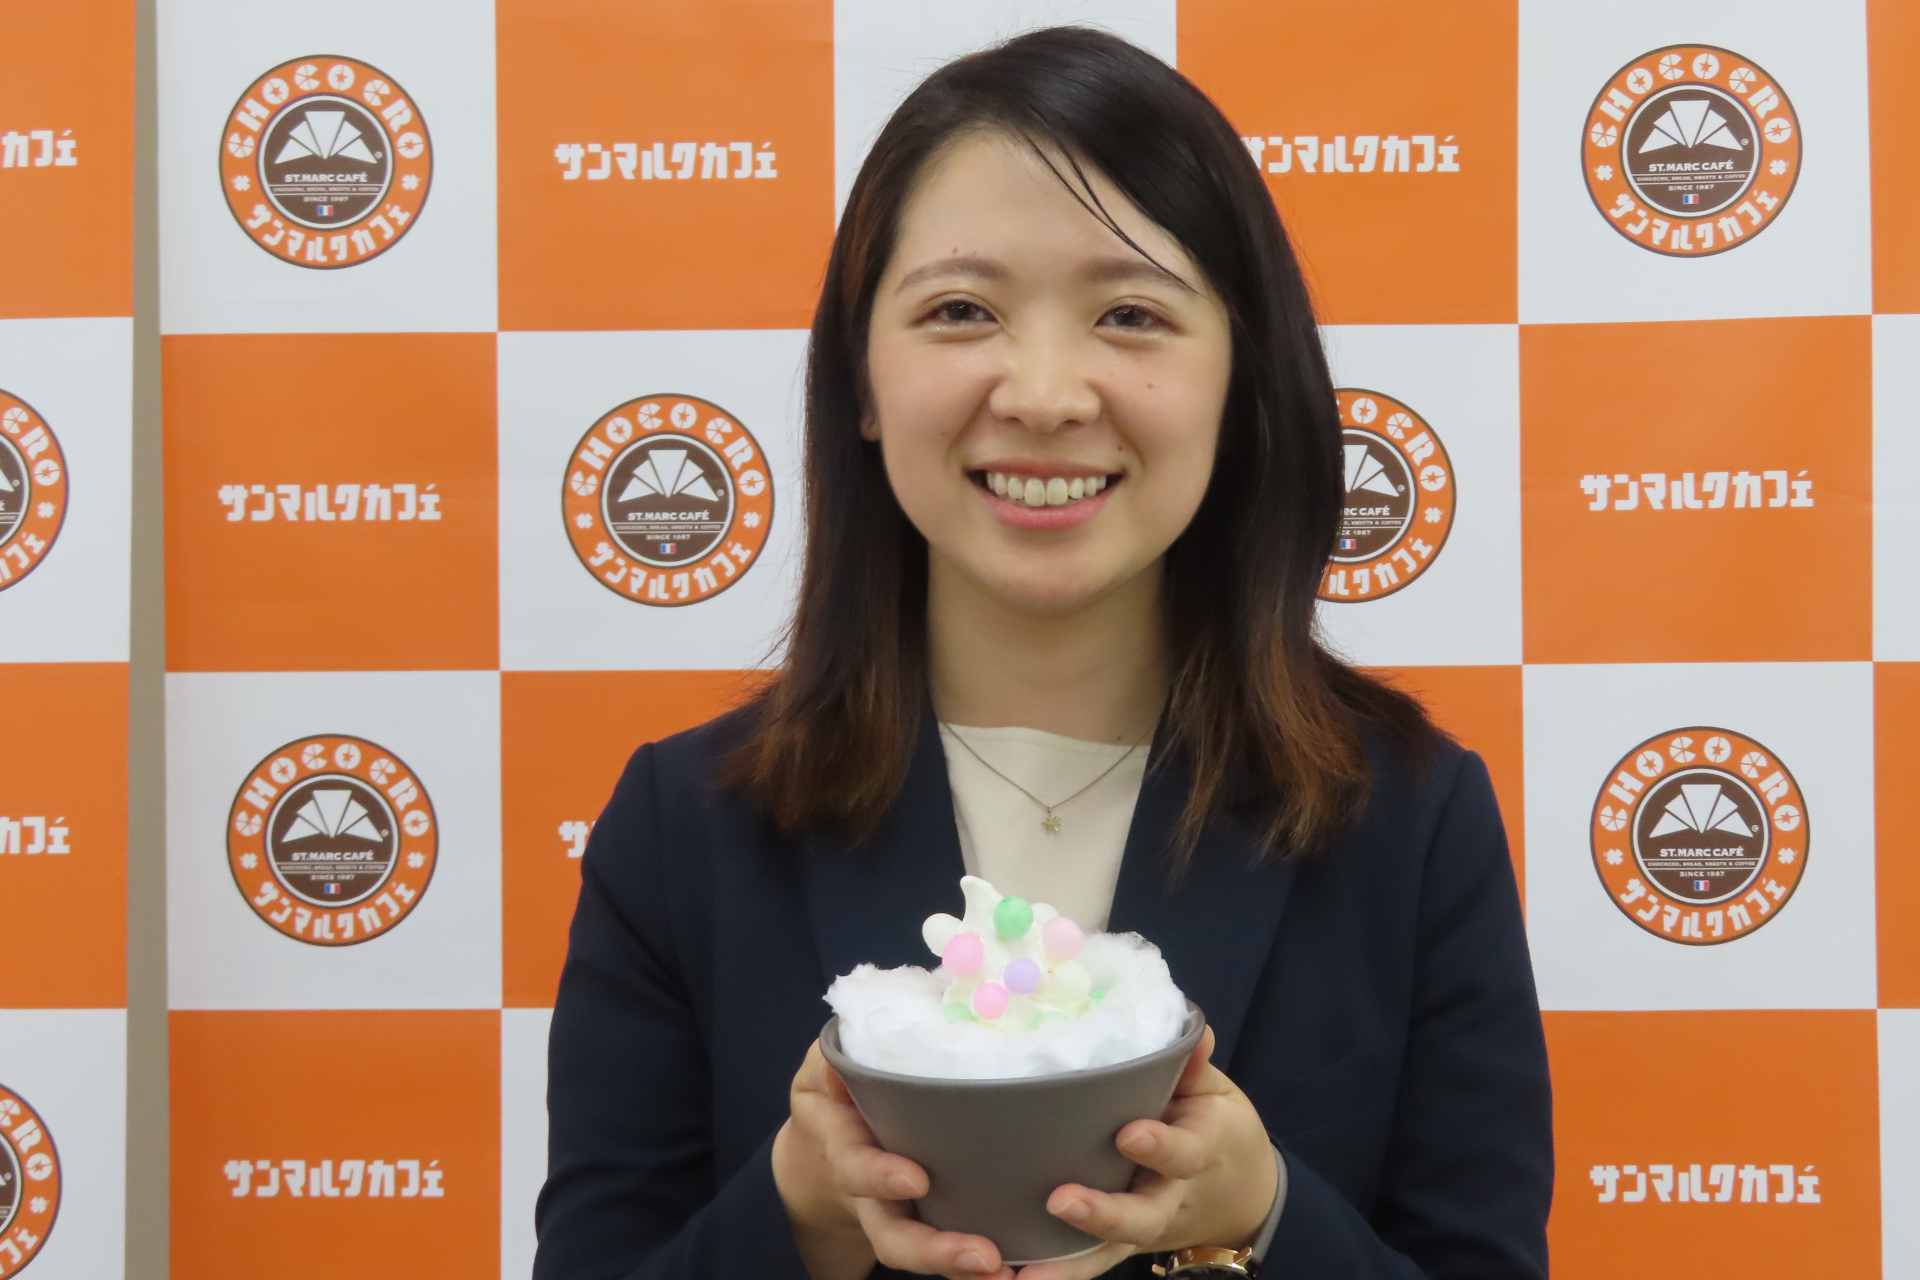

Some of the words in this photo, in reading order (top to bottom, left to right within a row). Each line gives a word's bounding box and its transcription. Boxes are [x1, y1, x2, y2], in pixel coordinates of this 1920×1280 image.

[336, 172, 367, 182] CAFÉ
[554, 141, 777, 181] サンマルクカフェ
[1649, 162, 1700, 172] ST.MARC
[1702, 159, 1734, 171] CAFÉ
[247, 203, 410, 262] サンマルクカフェ
[1610, 190, 1779, 249] サンマルクカフェ
[218, 483, 441, 522] サンマルクカフェ
[1580, 470, 1814, 511] サンマルクカフェ
[628, 511, 678, 521] ST.MARC
[679, 509, 710, 520] CAFÉ
[1359, 505, 1390, 516] CAFÉ
[589, 542, 752, 600] サンマルクカフェ
[343, 849, 374, 861] CAFÉ
[1660, 848, 1711, 857] ST.MARC
[1713, 845, 1744, 857] CAFÉ
[254, 882, 416, 940] サンマルクカフェ
[1620, 878, 1786, 937] サンマルクカフェ
[224, 1159, 444, 1198] サンマルクカフェ
[1590, 1164, 1821, 1203] サンマルクカフェ
